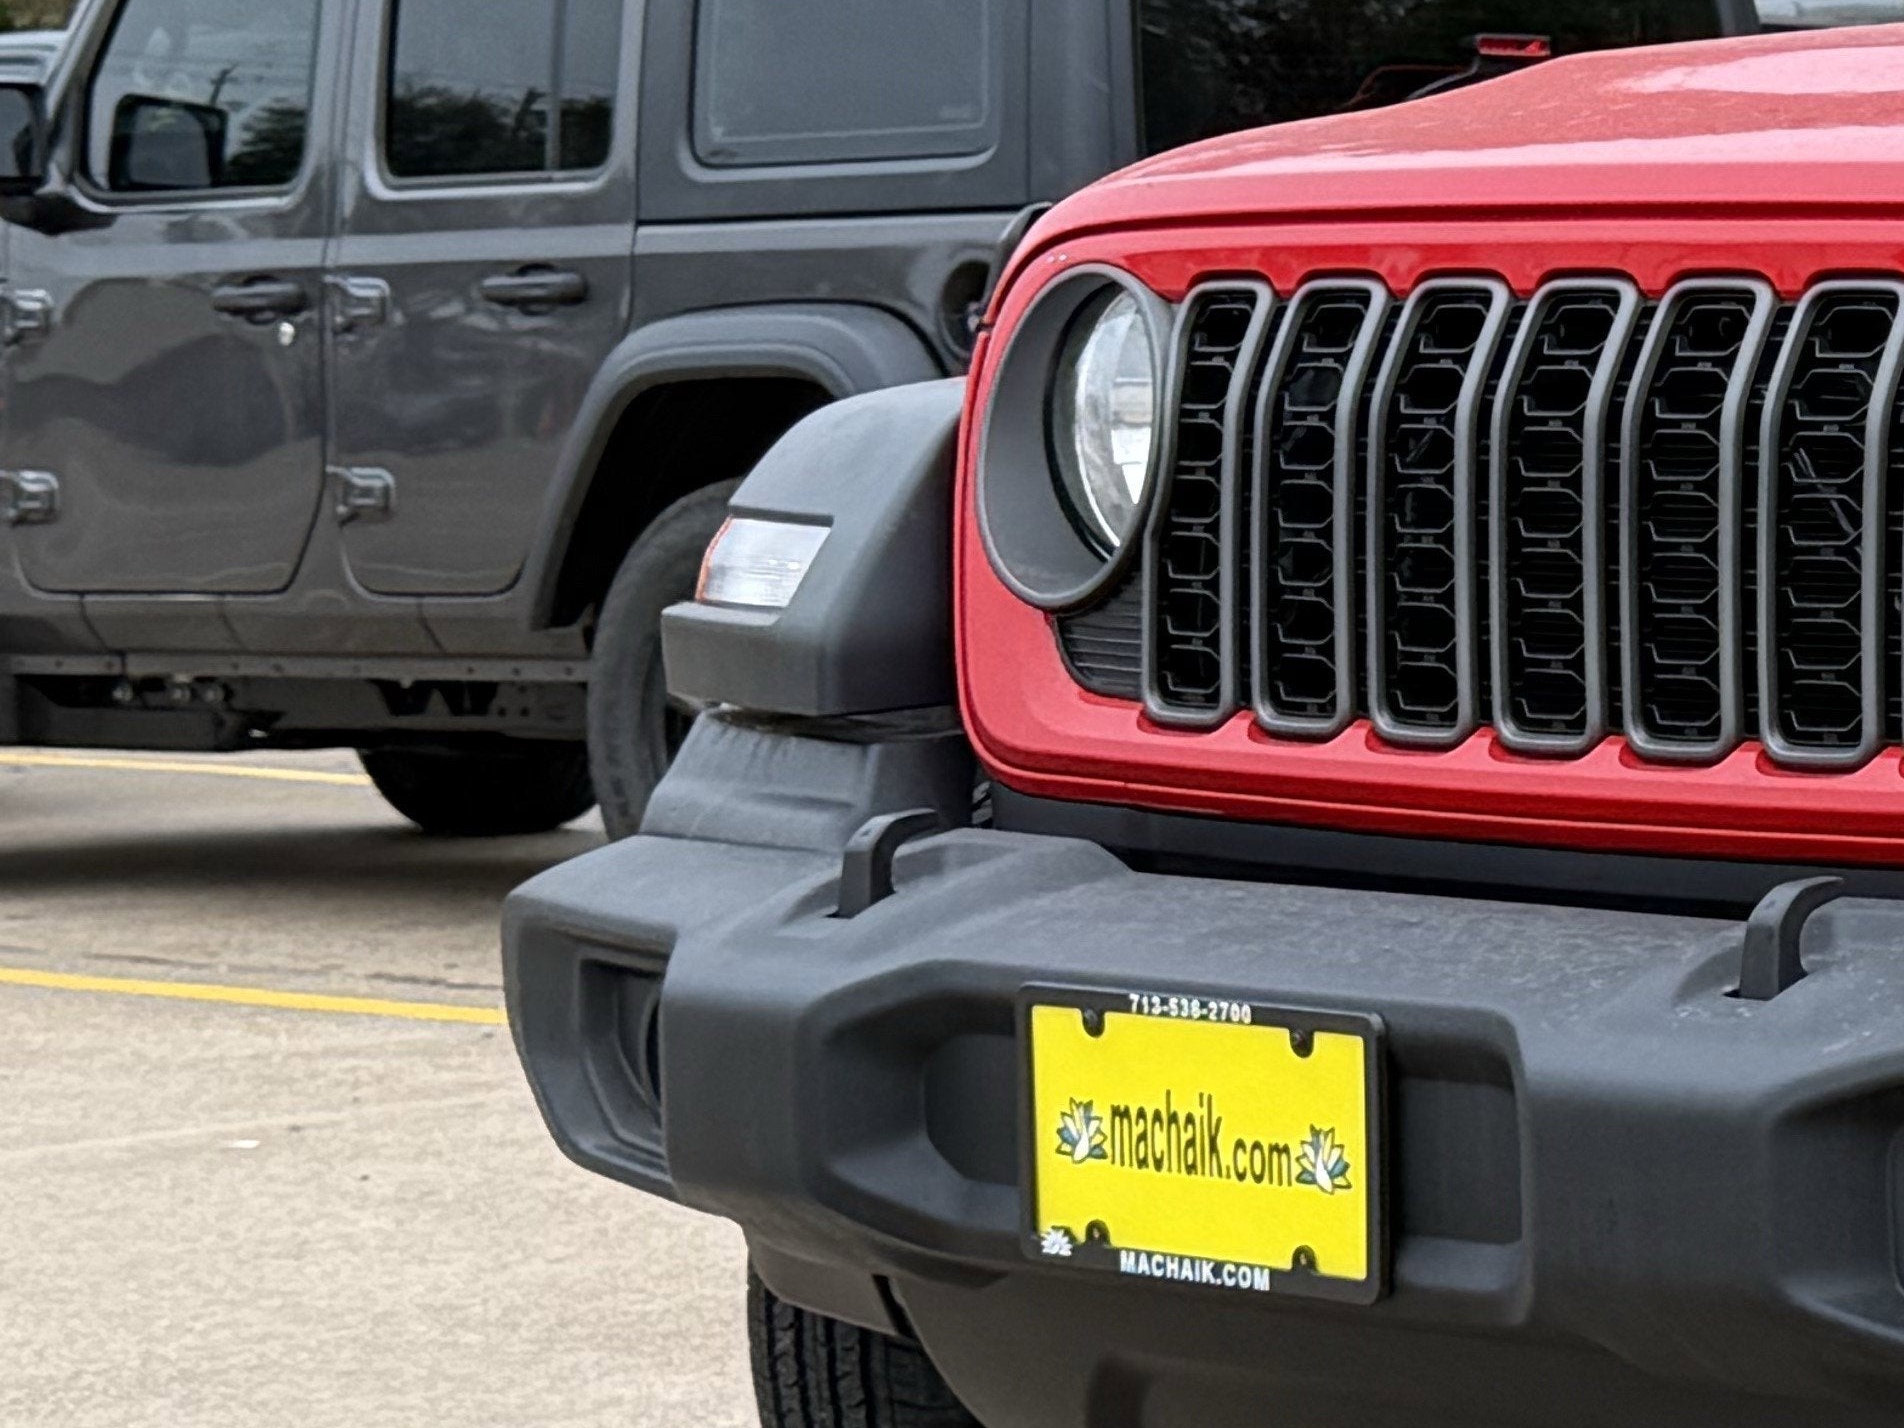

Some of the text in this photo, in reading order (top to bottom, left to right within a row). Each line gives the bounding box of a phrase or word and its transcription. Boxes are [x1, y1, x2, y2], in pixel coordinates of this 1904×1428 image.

[1128, 992, 1252, 1025] 713-538-2700
[1111, 1089, 1293, 1187] machaik.com
[1119, 1249, 1271, 1292] MACHAIK.COM
